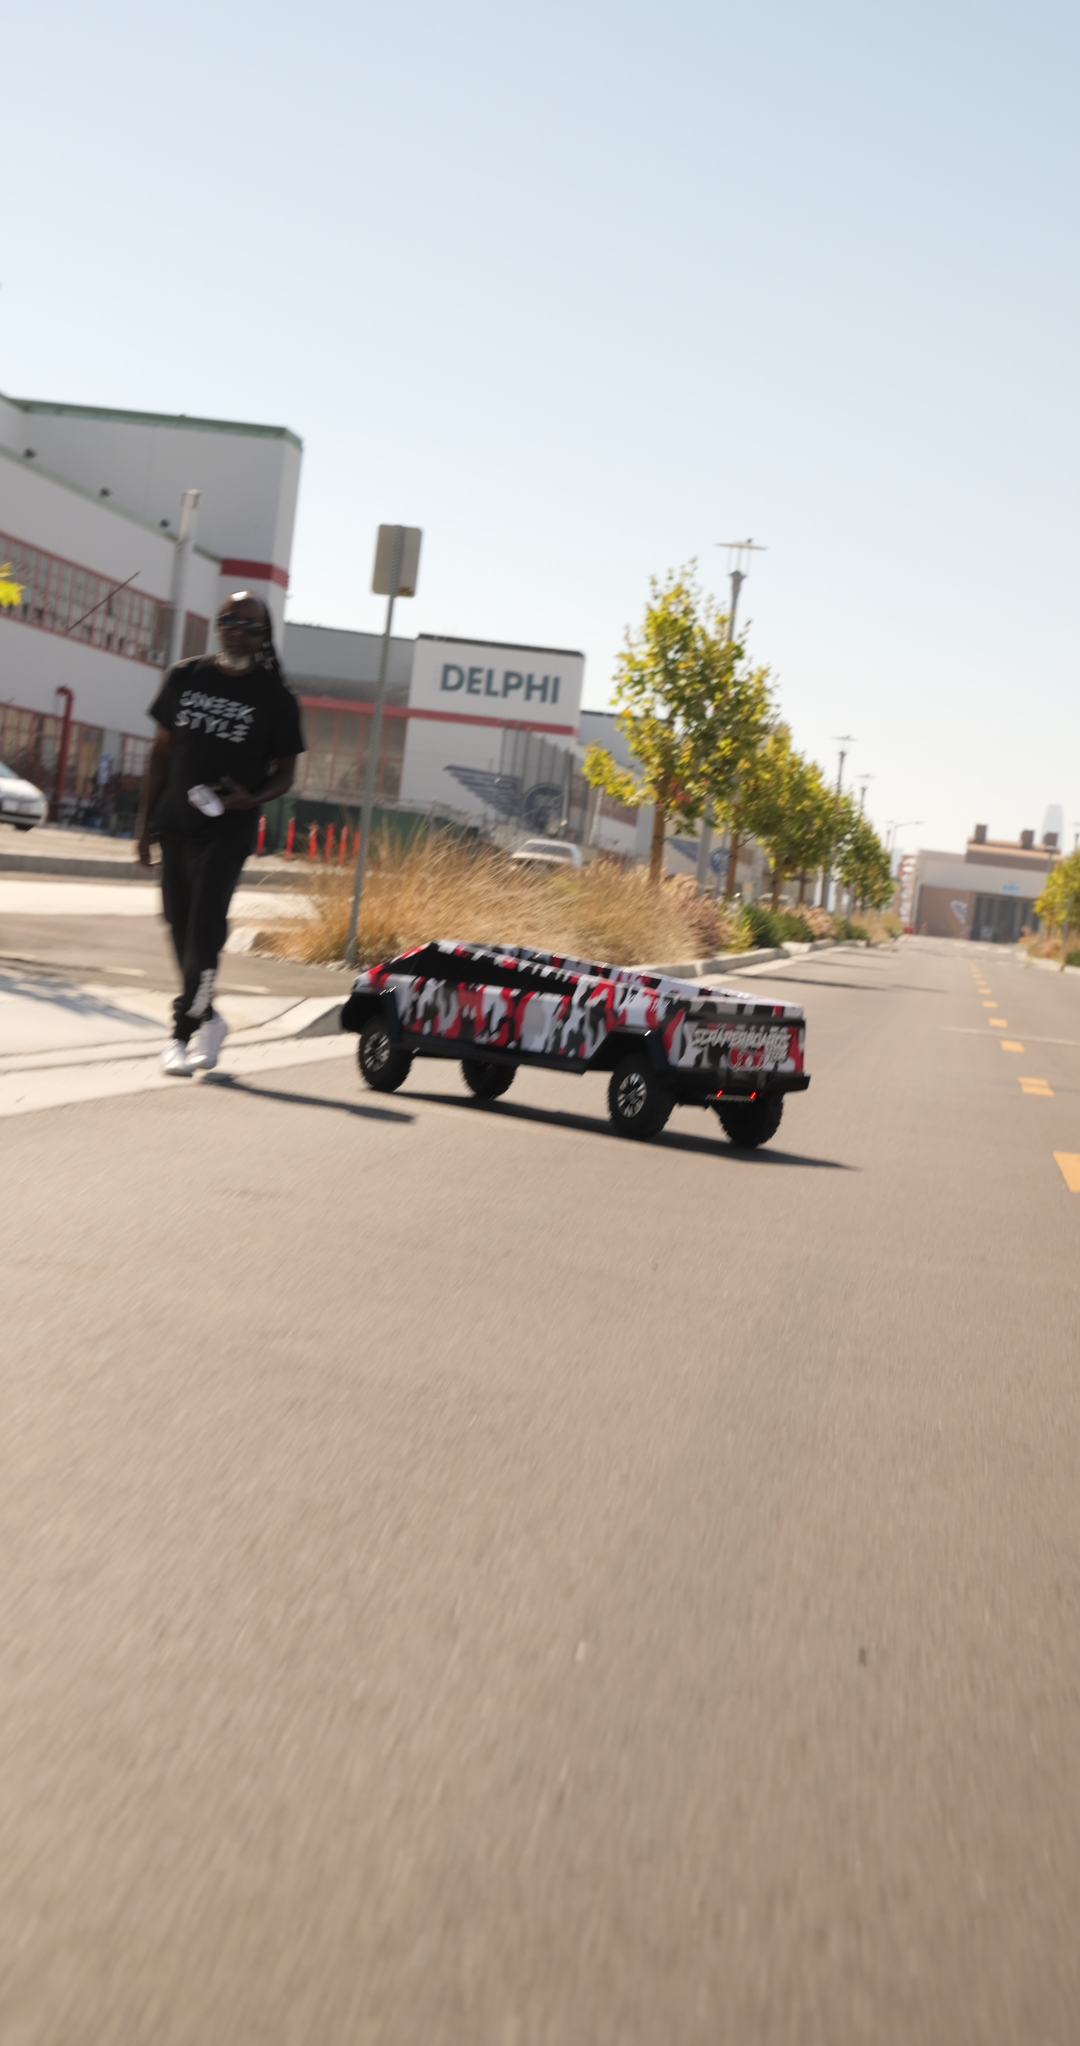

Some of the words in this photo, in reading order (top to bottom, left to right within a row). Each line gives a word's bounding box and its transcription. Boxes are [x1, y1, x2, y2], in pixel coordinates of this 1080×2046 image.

[440, 663, 560, 704] DELPHI
[179, 690, 256, 724] UNEEK
[174, 709, 250, 743] STYLE
